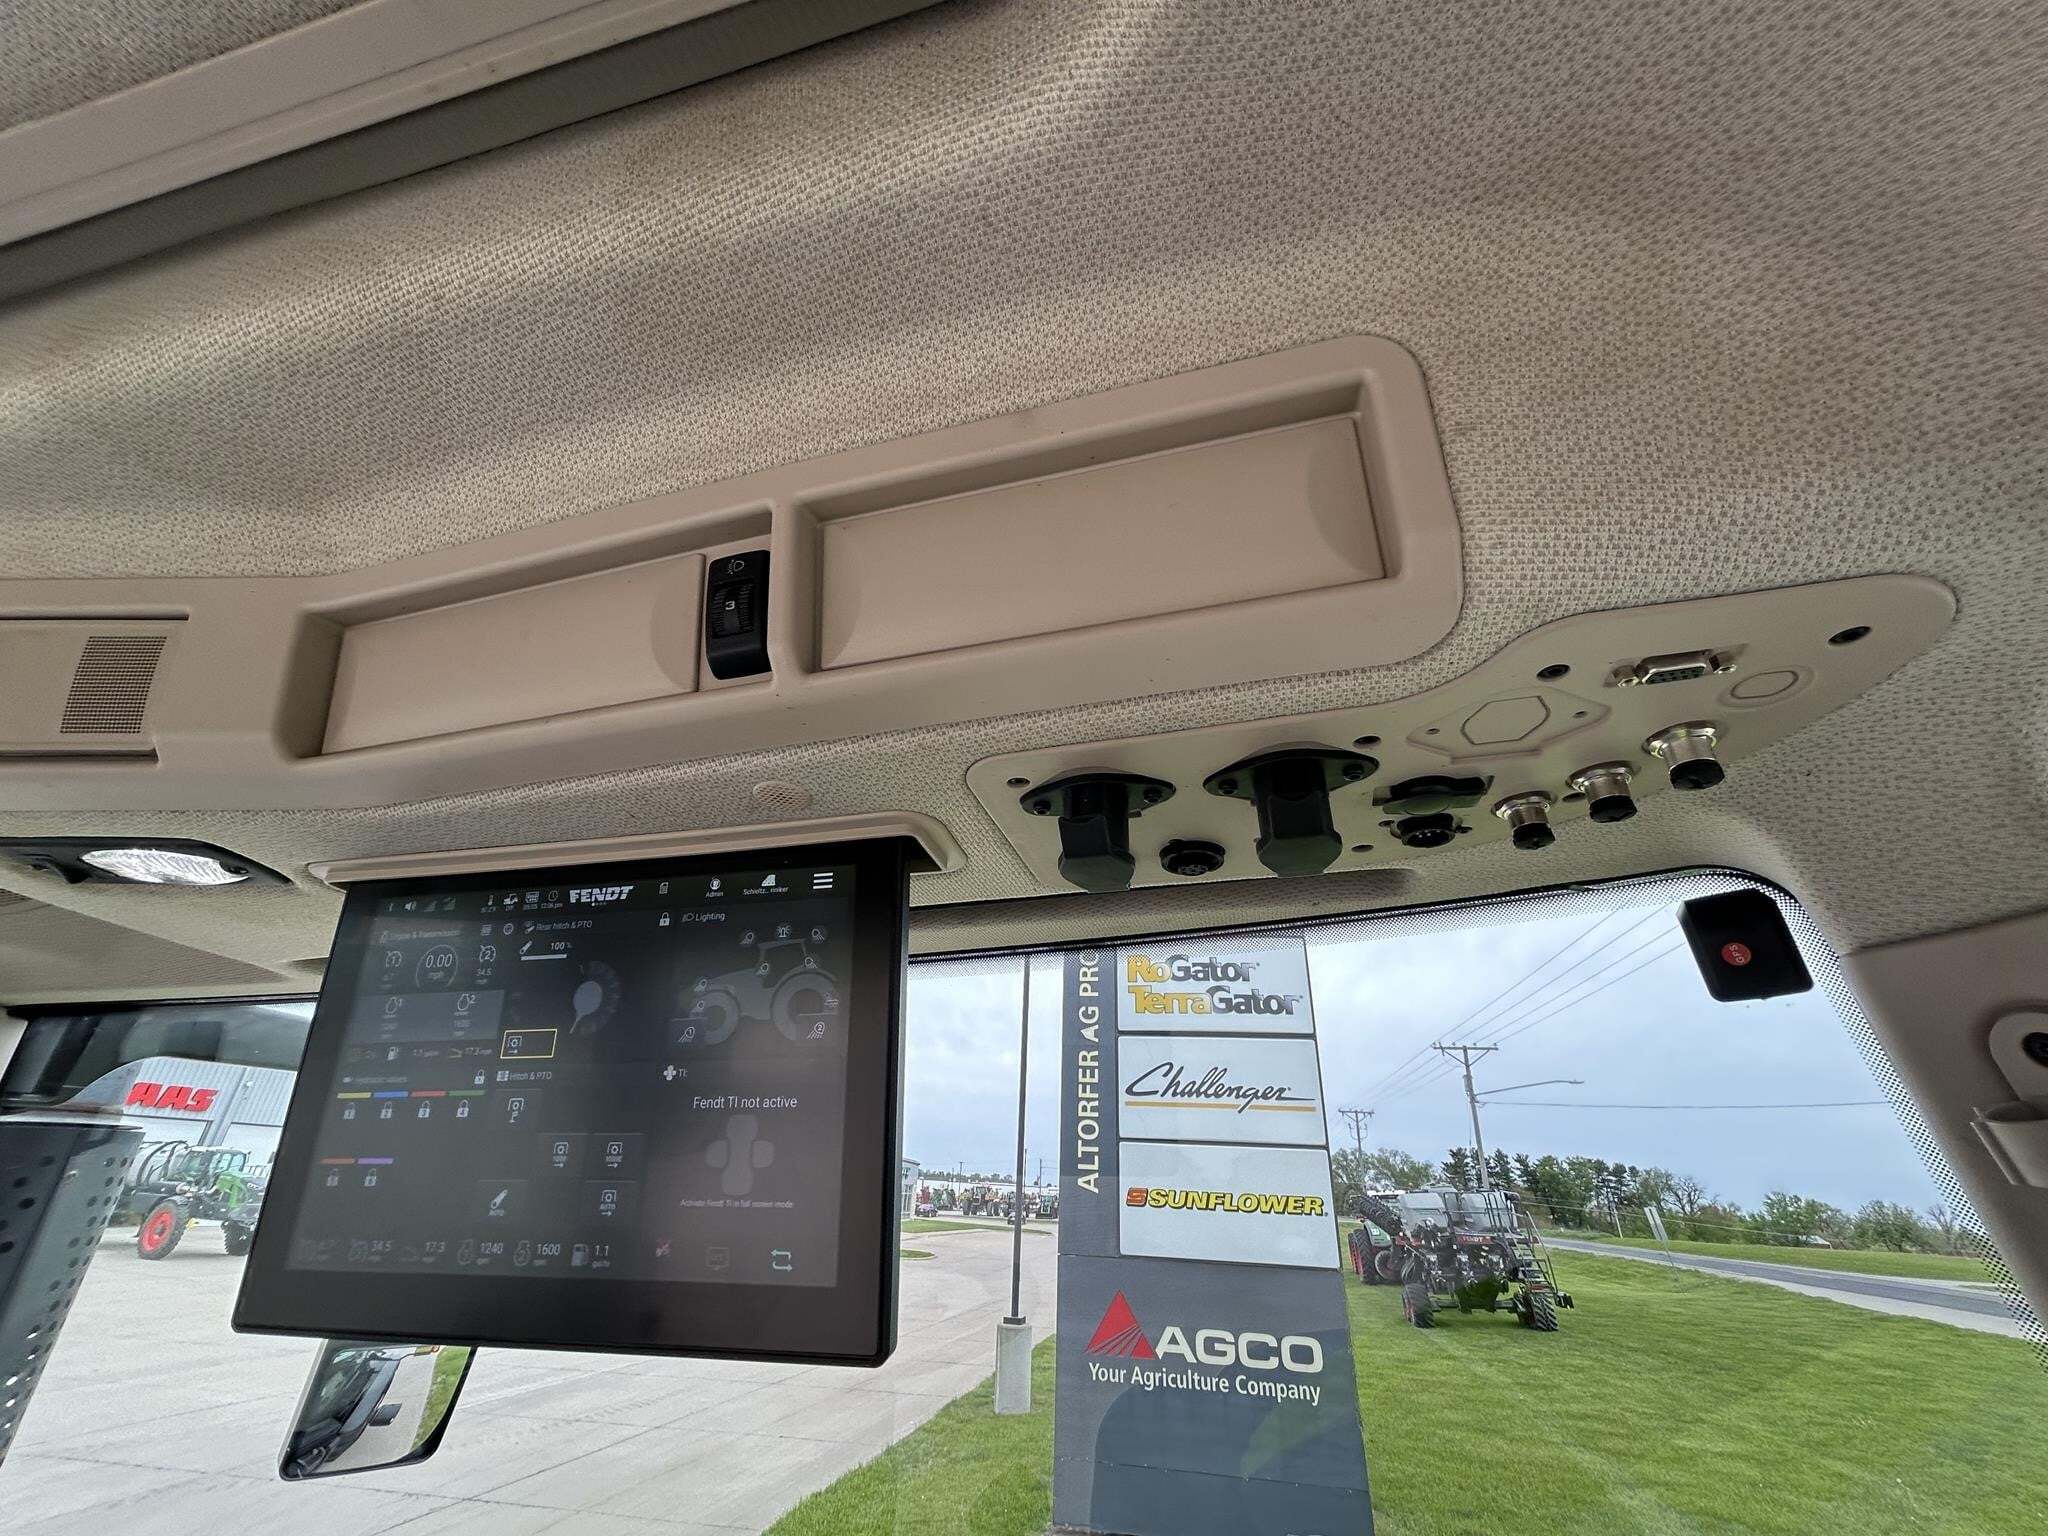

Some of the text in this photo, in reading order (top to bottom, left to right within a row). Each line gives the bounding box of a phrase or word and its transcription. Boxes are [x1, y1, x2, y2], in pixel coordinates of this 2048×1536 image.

[569, 885, 634, 903] FENDT
[576, 920, 593, 929] PTO
[695, 911, 726, 923] Lighting
[550, 941, 565, 950] 100
[1729, 944, 1745, 964] GPS
[425, 953, 453, 968] 0.00
[1127, 954, 1256, 983] RoGator
[1127, 985, 1300, 1016] TerraGator
[1078, 1006, 1099, 1043] AG
[535, 1071, 552, 1080] PTO
[1125, 1062, 1316, 1114] Challenger
[693, 1096, 798, 1109] Fendt TI not active
[1077, 1050, 1099, 1194] ALTORFER
[1149, 1189, 1324, 1216] SUNFLOWER
[537, 1243, 561, 1256] 1600
[1155, 1325, 1324, 1373] AGCO
[1088, 1362, 1321, 1406] Your Agriculture Company
